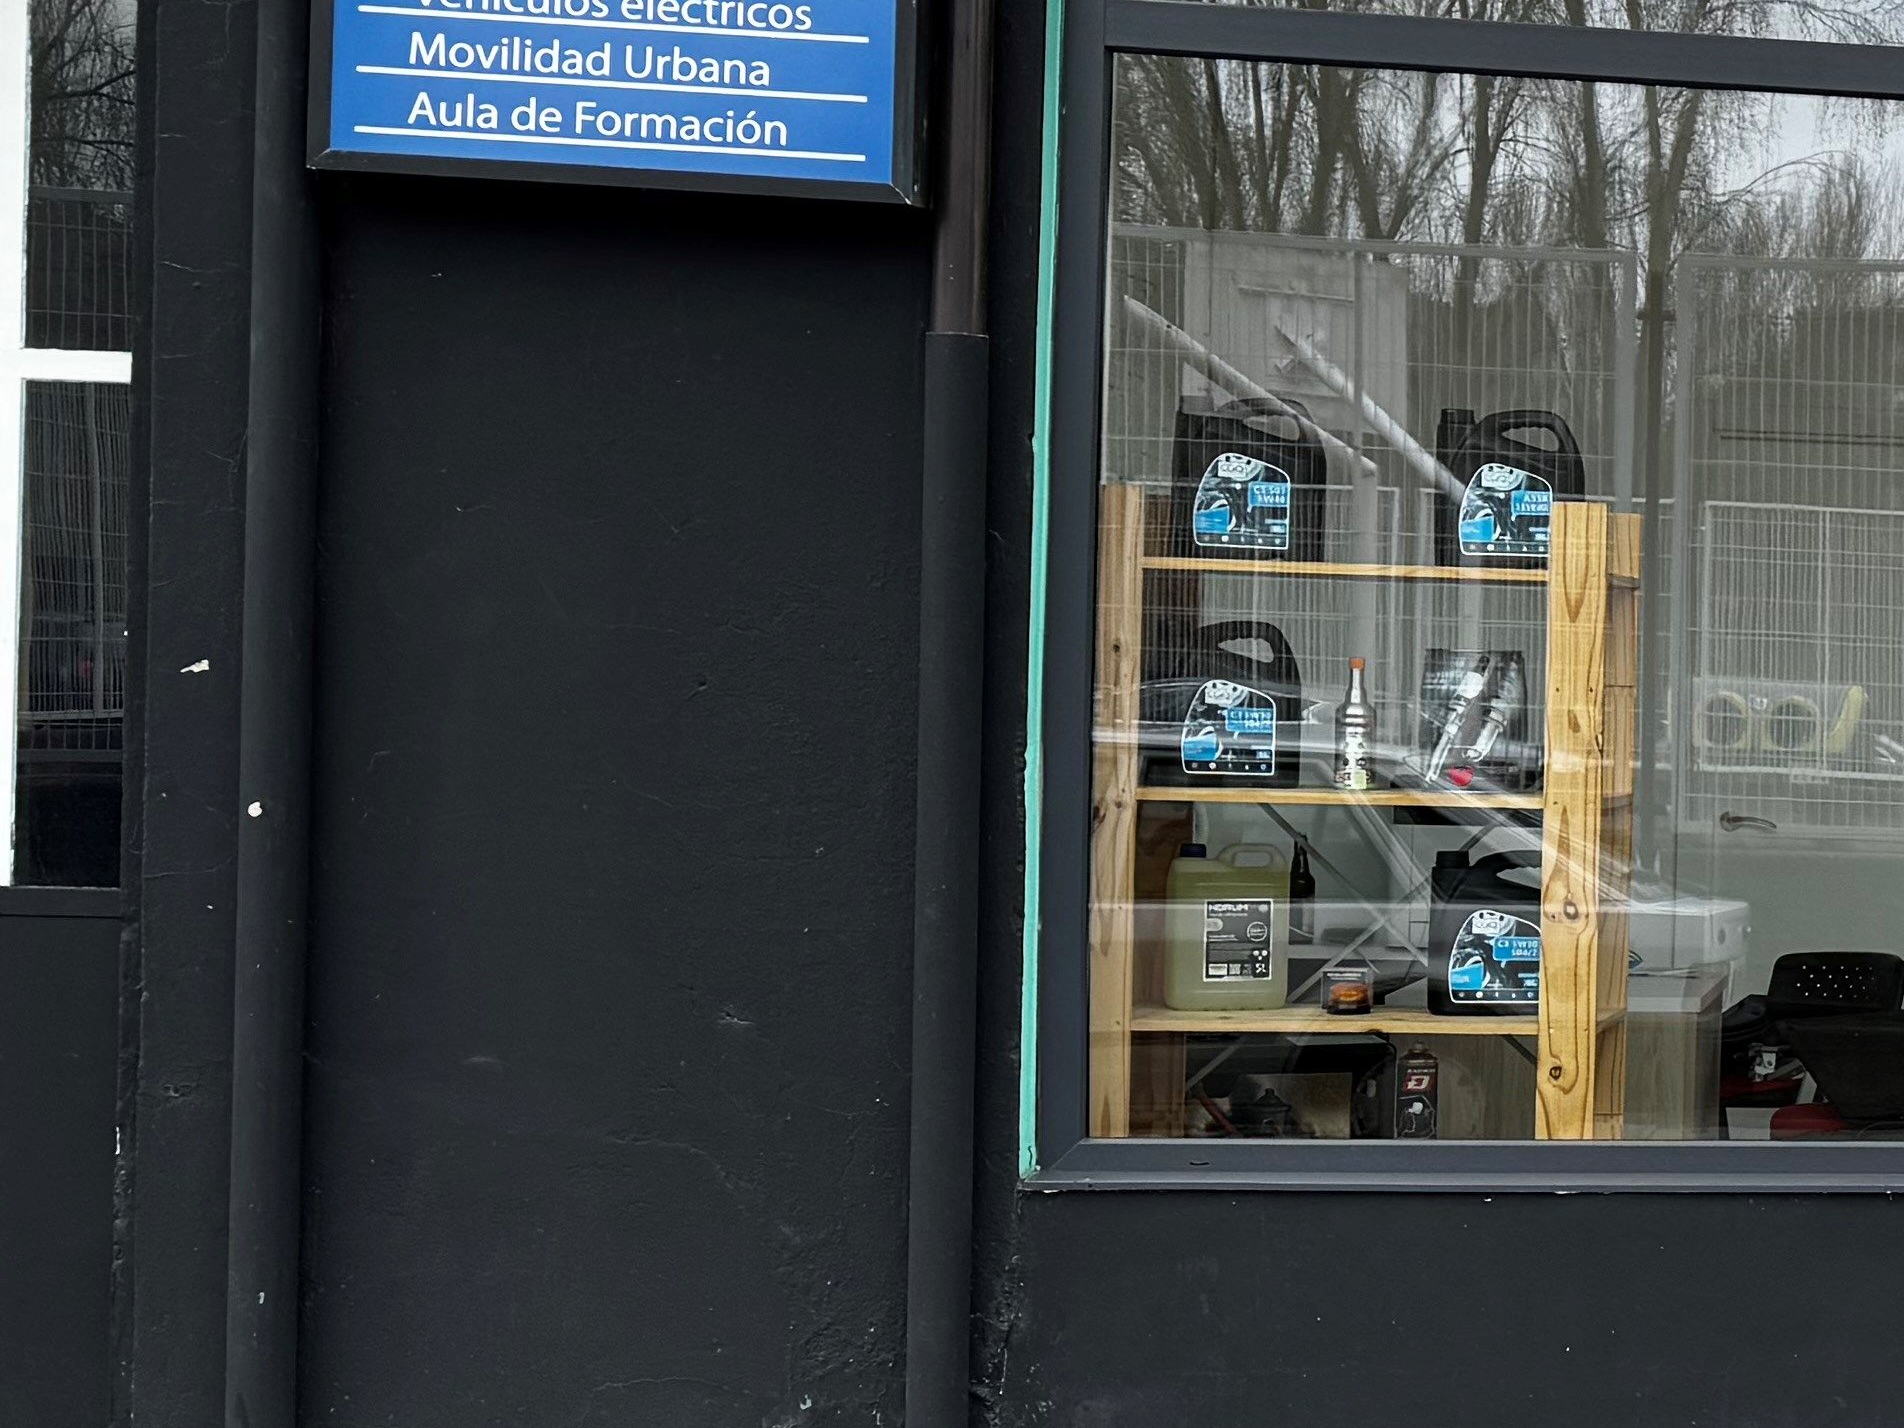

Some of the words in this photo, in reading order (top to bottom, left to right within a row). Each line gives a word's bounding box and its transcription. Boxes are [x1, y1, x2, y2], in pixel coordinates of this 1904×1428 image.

[409, 32, 611, 76] Movilidad
[625, 45, 770, 86] Urbana
[408, 92, 498, 129] Aula
[511, 97, 562, 133] de
[575, 101, 787, 146] Formación
